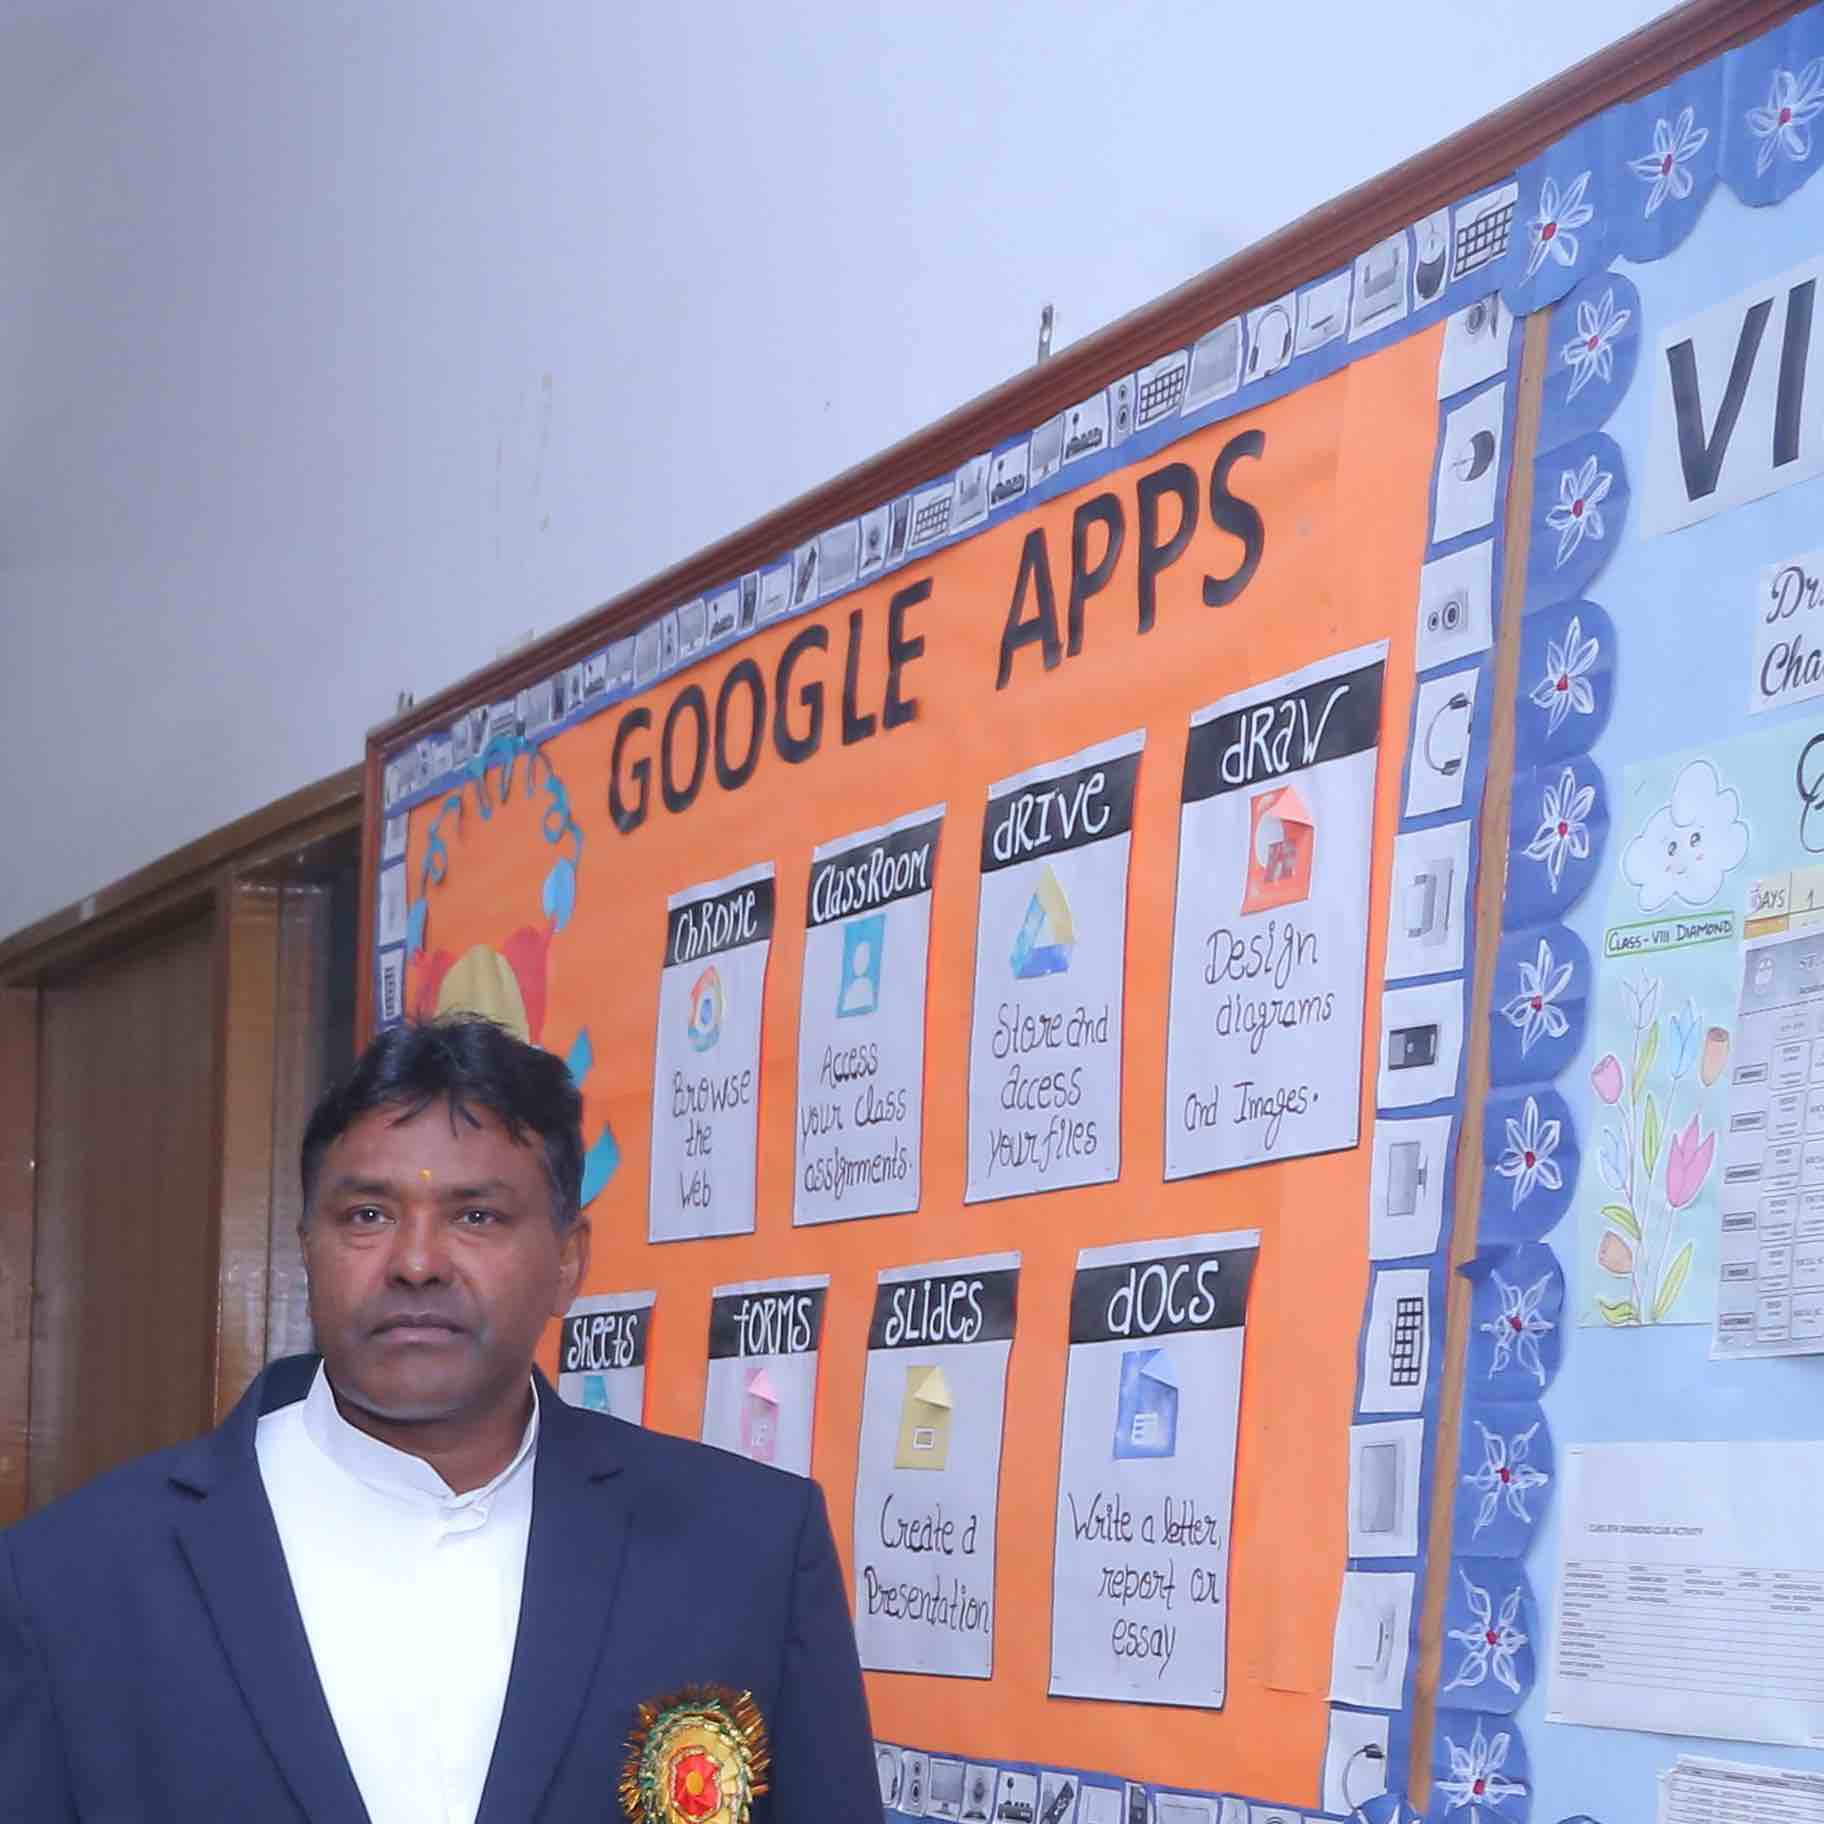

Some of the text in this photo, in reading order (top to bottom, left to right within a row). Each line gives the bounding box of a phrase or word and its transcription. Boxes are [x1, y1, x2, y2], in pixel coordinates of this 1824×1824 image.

[609, 429, 1266, 835] GOOGLE APPS
[1760, 634, 1824, 696] Cha
[1205, 920, 1318, 990] Design
[1677, 919, 1732, 942] DIAMOND
[992, 1002, 1109, 1059] Store and
[1216, 992, 1335, 1054] diagrams
[673, 1069, 751, 1118] Browse
[820, 1043, 878, 1088] Access
[1001, 1064, 1083, 1111] access
[685, 1117, 712, 1157] the
[801, 1104, 843, 1155] your
[987, 1115, 1097, 1178] your files
[880, 1493, 977, 1555] Create a
[1067, 1491, 1134, 1543] Write
[1141, 1514, 1155, 1544] a
[864, 1565, 989, 1634] Presentation
[1098, 1557, 1220, 1611] report or
[1112, 1617, 1176, 1681] essay
